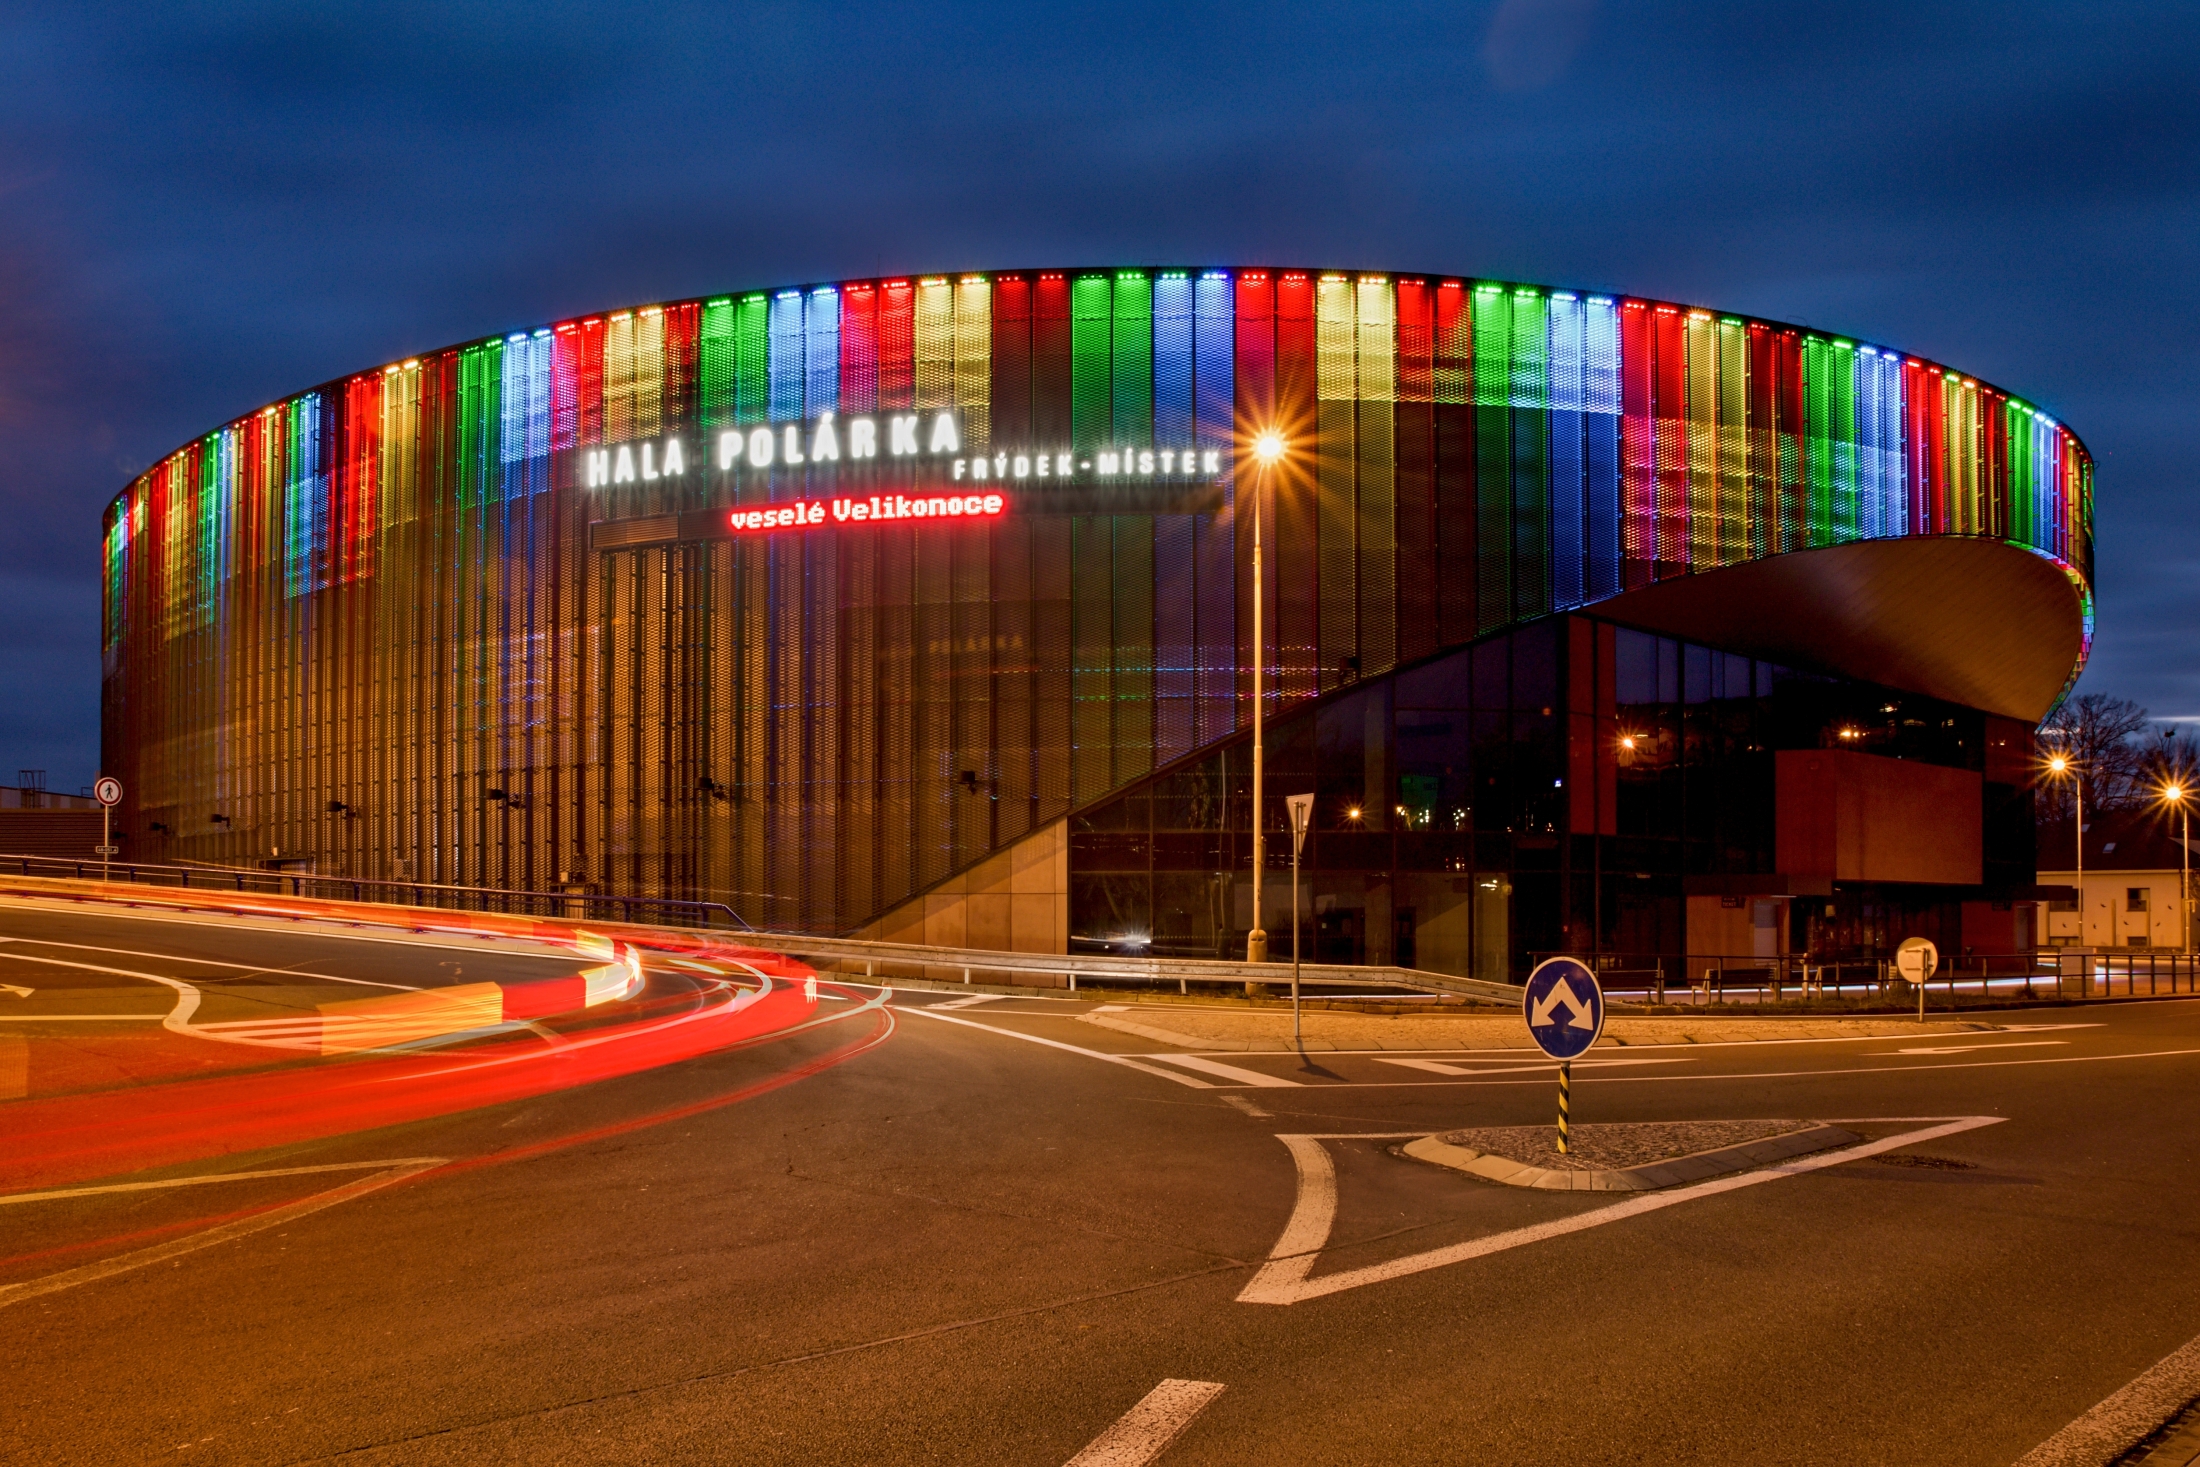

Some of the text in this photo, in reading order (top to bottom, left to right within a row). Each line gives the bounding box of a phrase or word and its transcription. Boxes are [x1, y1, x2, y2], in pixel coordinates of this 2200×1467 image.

[588, 412, 959, 488] HALA POLÁRKA
[731, 494, 1003, 530] veselé Velikonoce
